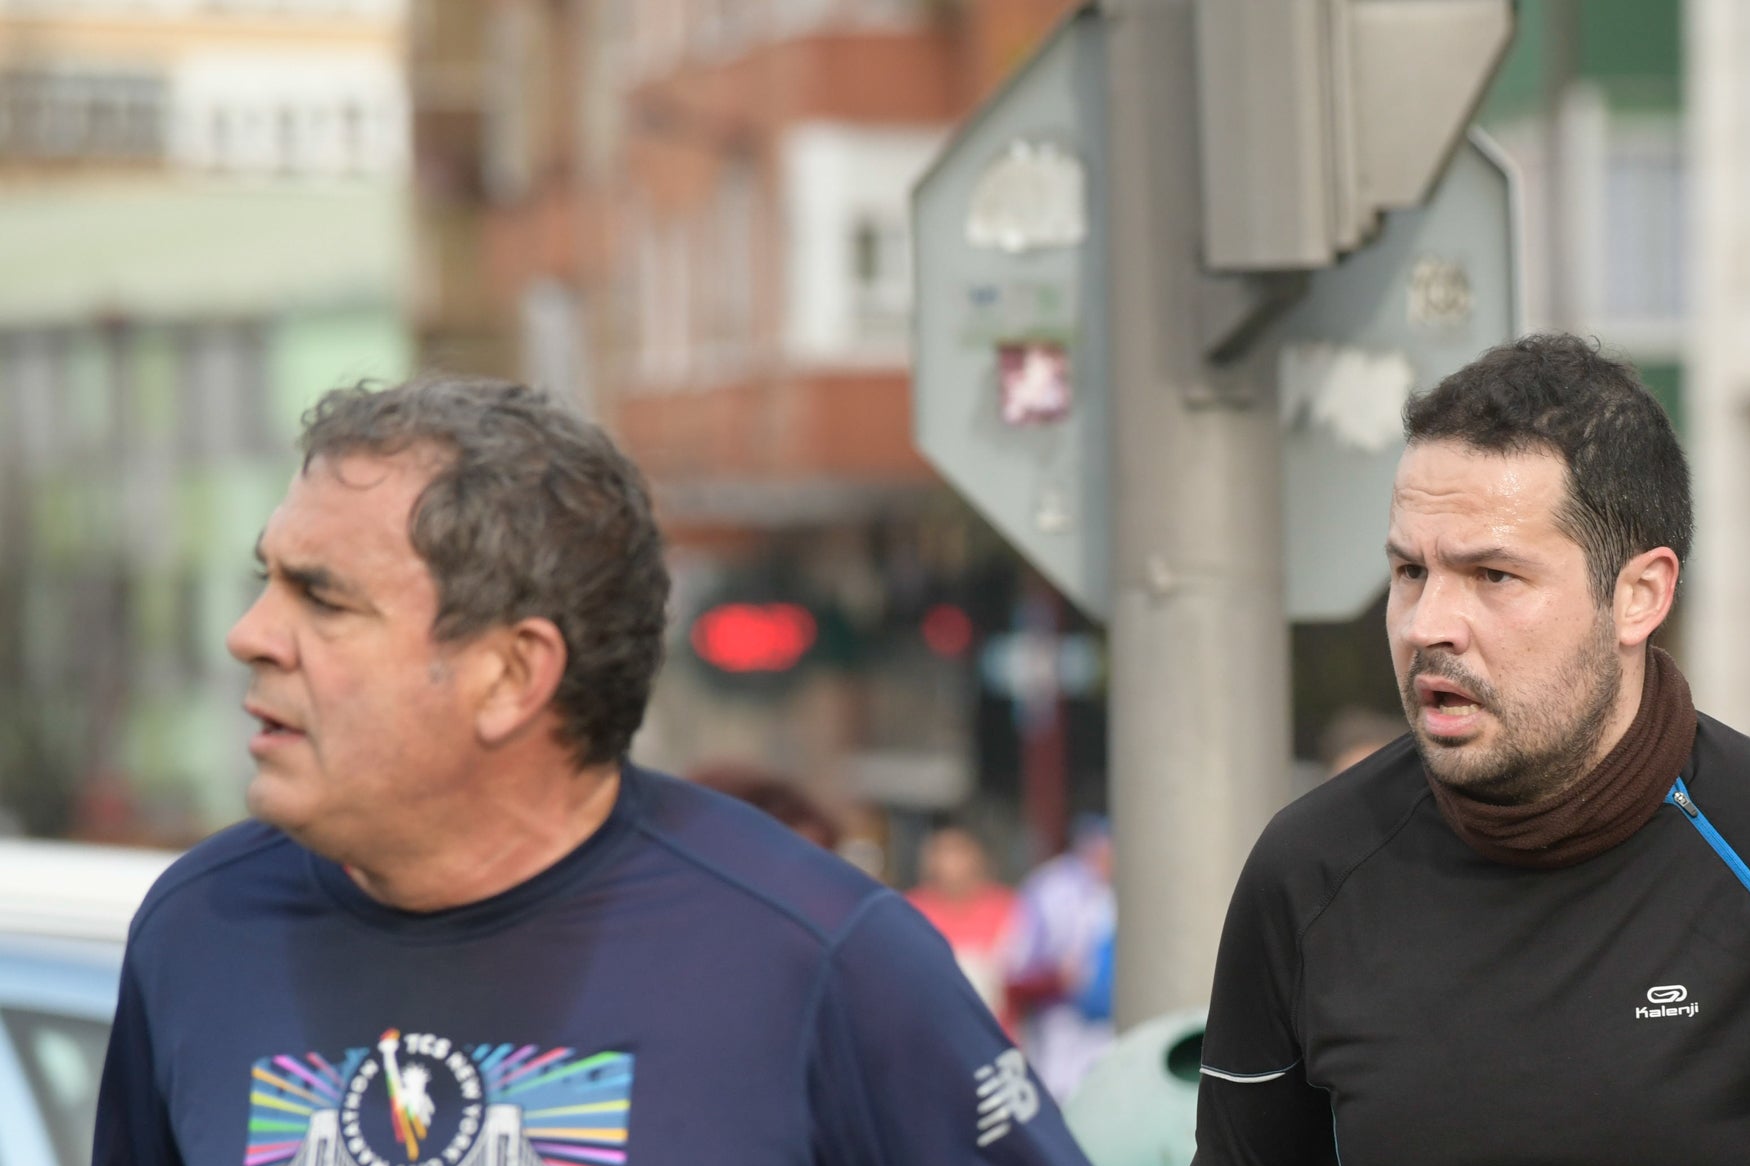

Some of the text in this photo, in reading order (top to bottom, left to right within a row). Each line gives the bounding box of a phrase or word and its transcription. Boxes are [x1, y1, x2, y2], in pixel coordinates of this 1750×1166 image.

[1635, 1002, 1699, 1019] Kalenji
[403, 1033, 452, 1060] TCS
[445, 1050, 482, 1100] NEW
[441, 1103, 482, 1165] YORK
